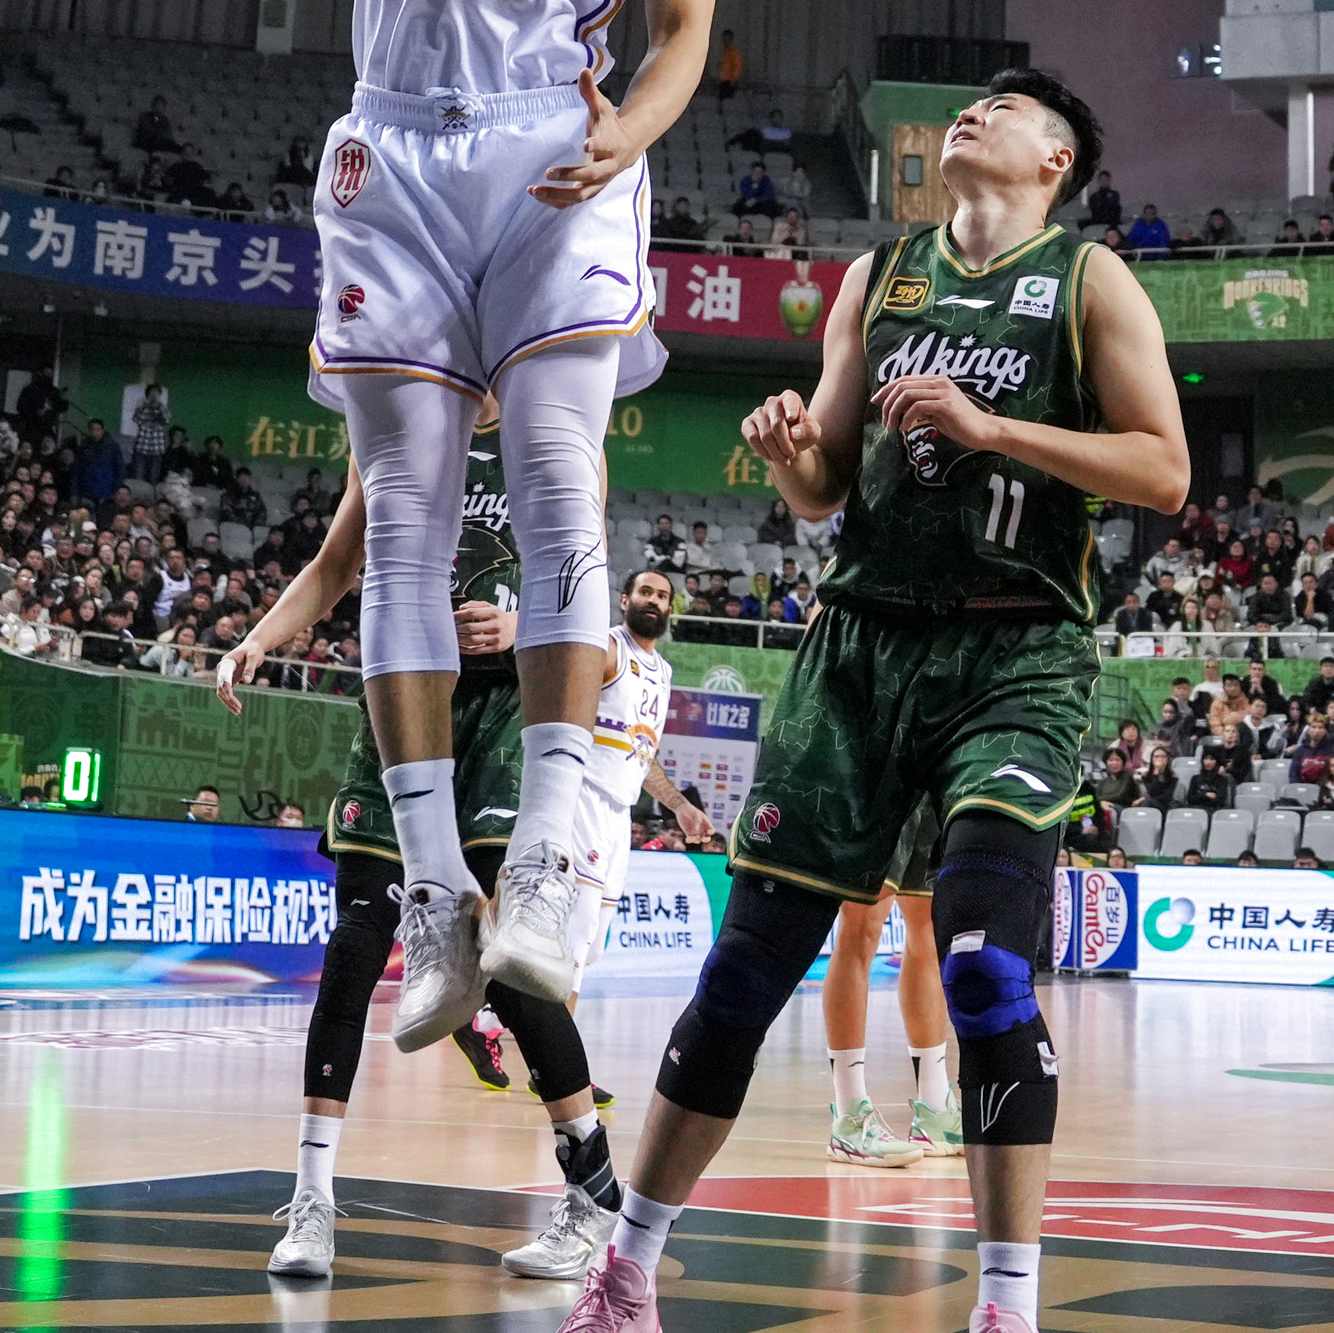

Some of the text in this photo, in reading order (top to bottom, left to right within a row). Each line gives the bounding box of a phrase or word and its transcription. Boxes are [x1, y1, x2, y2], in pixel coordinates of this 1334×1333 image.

[1013, 306, 1034, 314] CHINA
[1014, 299, 1050, 310] 中国人寿
[877, 331, 1032, 401] Mkings
[984, 472, 1026, 550] 11
[639, 688, 660, 722] 24
[64, 750, 90, 802] 0
[617, 892, 690, 924] 中国人寿
[618, 931, 693, 949] CHINA LIFE
[1207, 935, 1279, 951] CHINA
